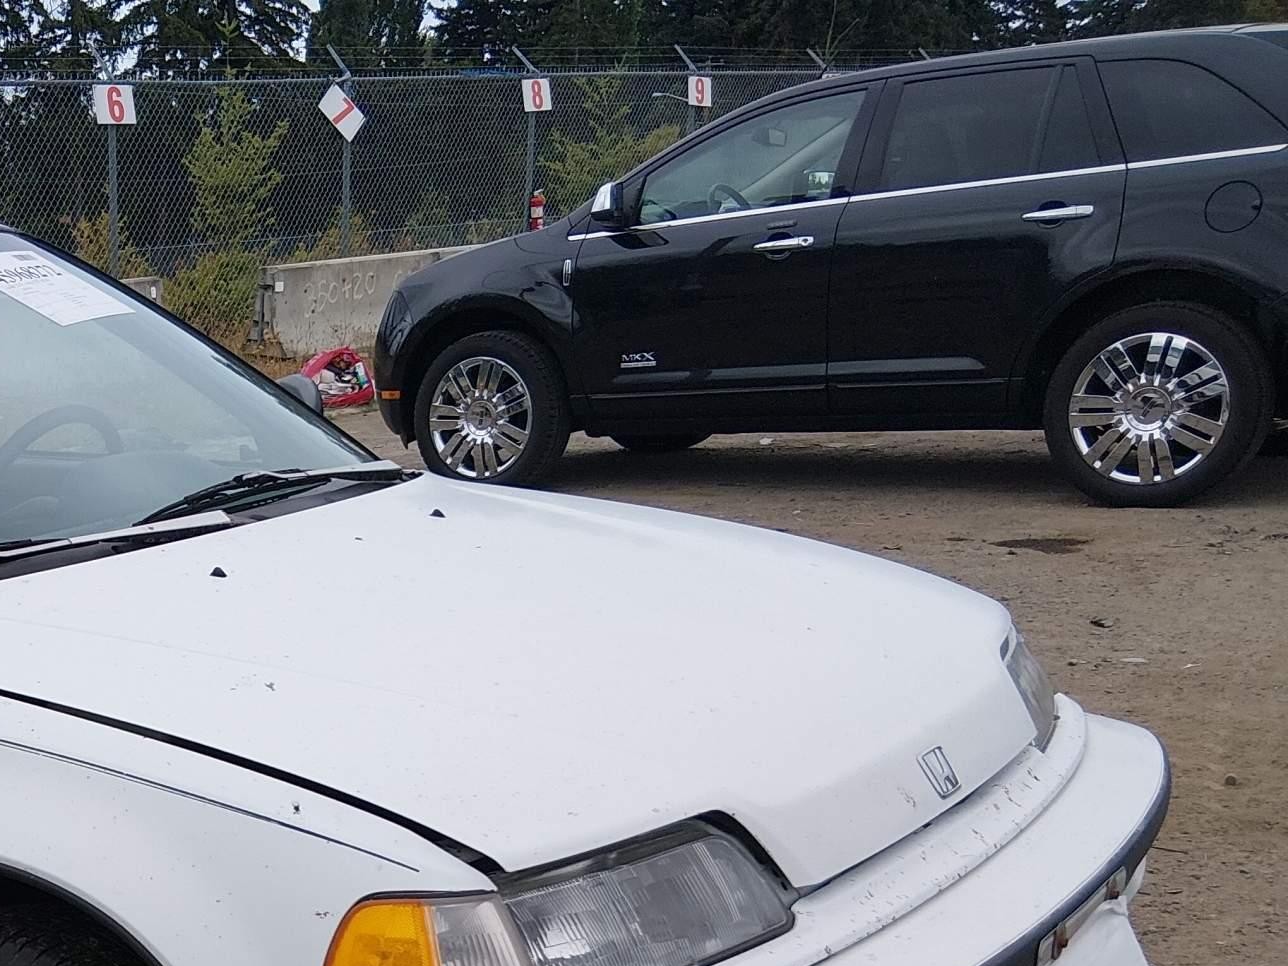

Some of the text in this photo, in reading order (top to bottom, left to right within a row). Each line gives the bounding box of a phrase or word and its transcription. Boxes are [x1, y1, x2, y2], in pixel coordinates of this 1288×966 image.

[107, 86, 125, 123] 6
[531, 80, 543, 109] 8
[695, 78, 705, 104] 9
[332, 97, 355, 125] 7
